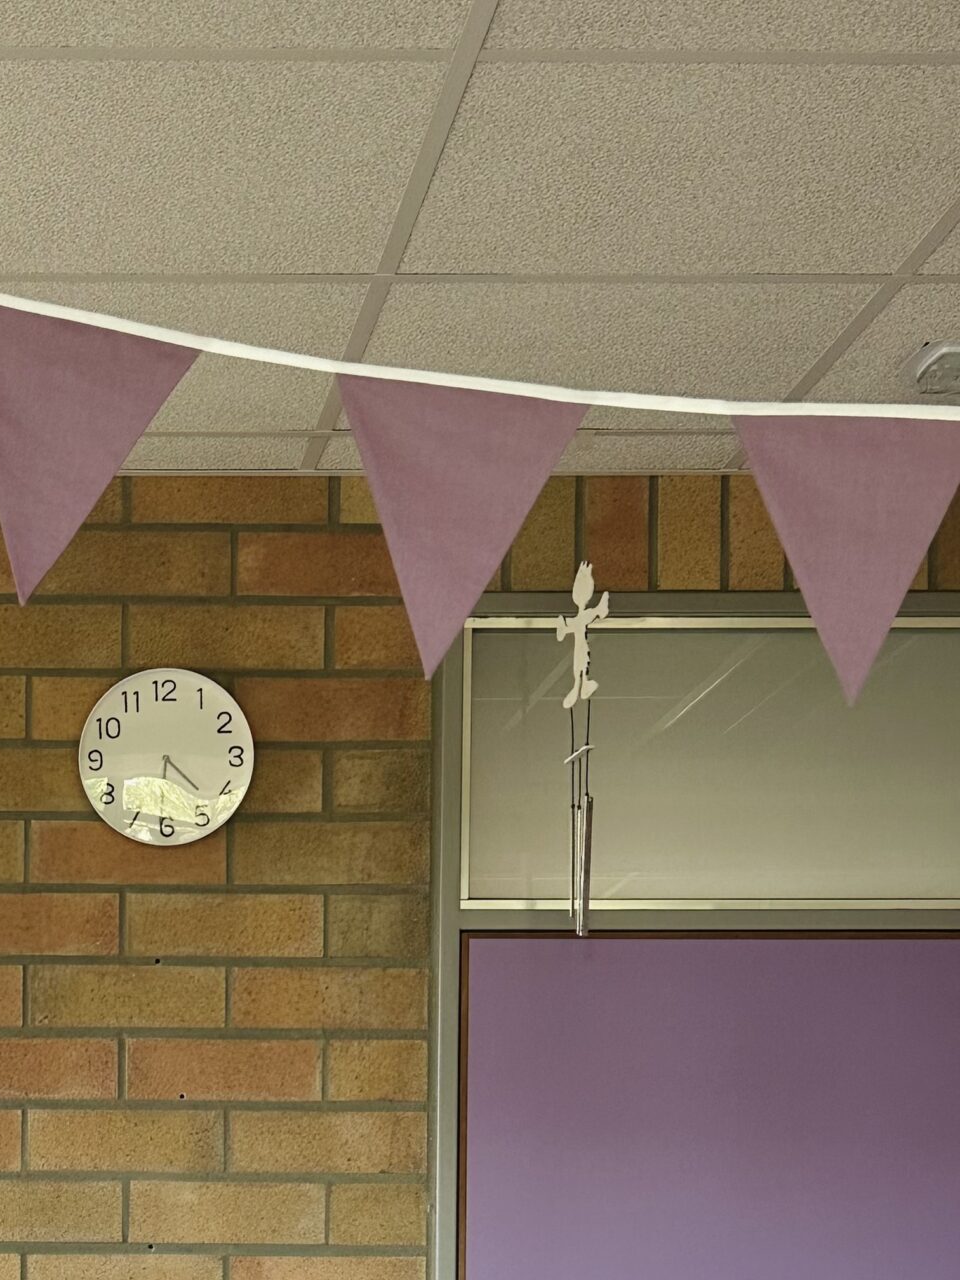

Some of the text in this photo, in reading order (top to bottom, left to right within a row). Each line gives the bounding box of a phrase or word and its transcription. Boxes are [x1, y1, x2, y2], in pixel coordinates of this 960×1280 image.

[121, 690, 140, 713] 11
[152, 679, 177, 702] 12
[196, 687, 203, 710] 1
[96, 717, 121, 739] 10
[216, 711, 232, 733] 2
[88, 750, 103, 771] 9
[228, 746, 244, 767] 3
[100, 783, 115, 805] 8
[194, 804, 210, 827] 5
[159, 816, 175, 838] 6
